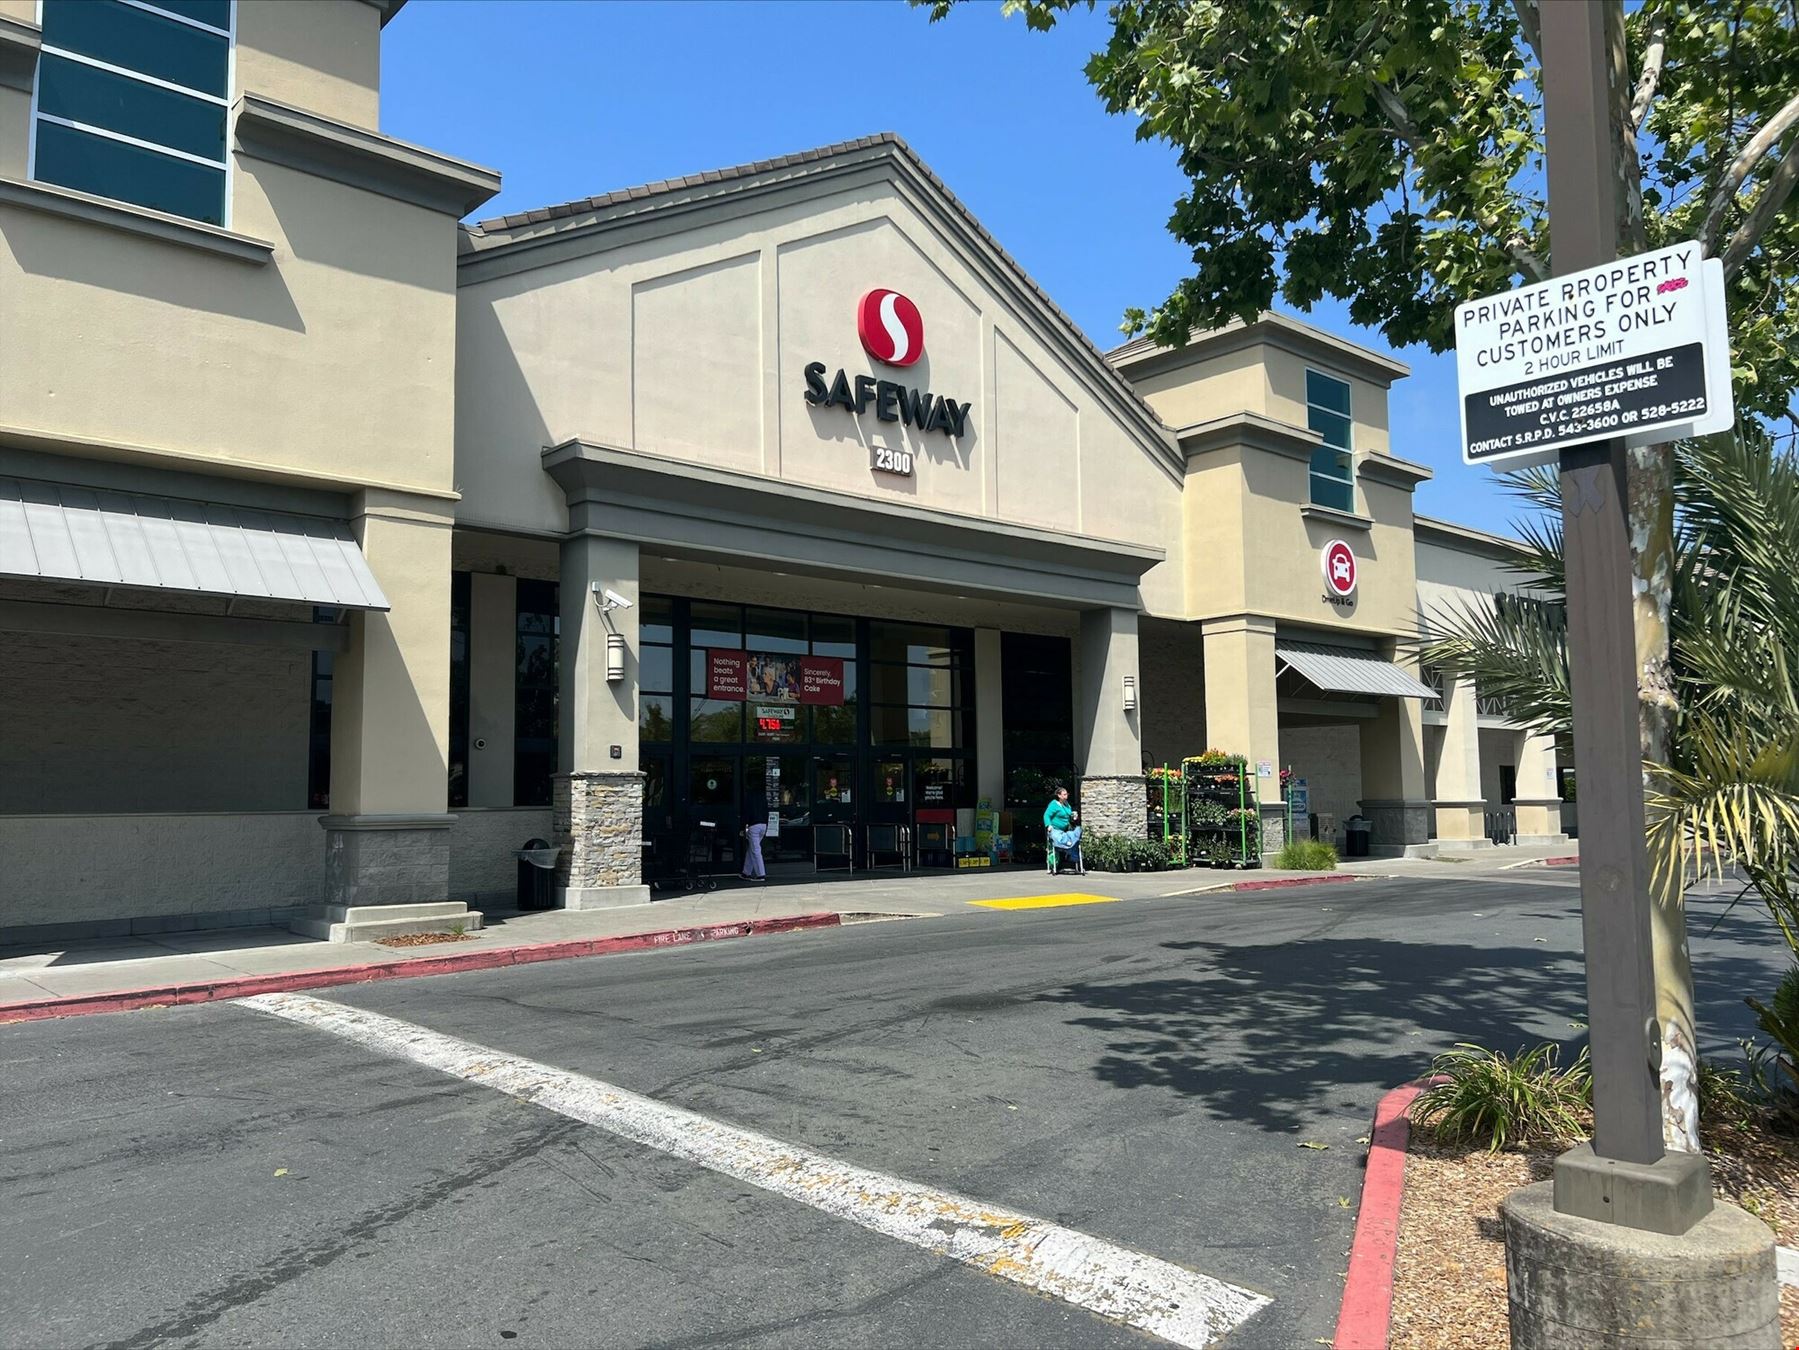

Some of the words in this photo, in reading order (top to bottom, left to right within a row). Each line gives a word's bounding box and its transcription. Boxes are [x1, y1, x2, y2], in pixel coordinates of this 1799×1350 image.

[1464, 289, 1550, 328] PRIVATE
[1562, 250, 1691, 302] PROPERTY
[1500, 300, 1595, 340] PARKING
[1606, 286, 1650, 313] FOR
[1477, 321, 1606, 367] CUSTOMERS
[1618, 302, 1677, 332] ONLY
[1525, 361, 1534, 375] 2
[1539, 350, 1581, 372] HOUR
[1587, 339, 1625, 360] LIMIT
[1489, 380, 1568, 406] UNAUTHORIZED
[1570, 367, 1624, 388] VEHICLES
[1626, 361, 1654, 376] WILL
[1656, 356, 1674, 370] BE
[1504, 401, 1539, 417] TOWED
[1541, 397, 1555, 409] AT
[1557, 387, 1602, 406] OWNERS
[1604, 374, 1658, 396] EXPENSE
[804, 361, 972, 438] SAFEWAY
[1571, 399, 1621, 418] 22658A
[1470, 435, 1513, 453] CONTACT
[1515, 427, 1556, 445] S.R.P.D.
[1558, 414, 1618, 436] 543-3600
[1621, 411, 1639, 424] OR
[1641, 397, 1705, 419] 528-5222
[876, 448, 911, 474] 2300
[713, 657, 741, 668] Nothing
[713, 666, 733, 675] beats
[713, 685, 746, 693] entrance.
[720, 677, 738, 685] great
[816, 677, 841, 687] Birthday
[654, 934, 671, 944] FIRE
[673, 930, 692, 942] LANE
